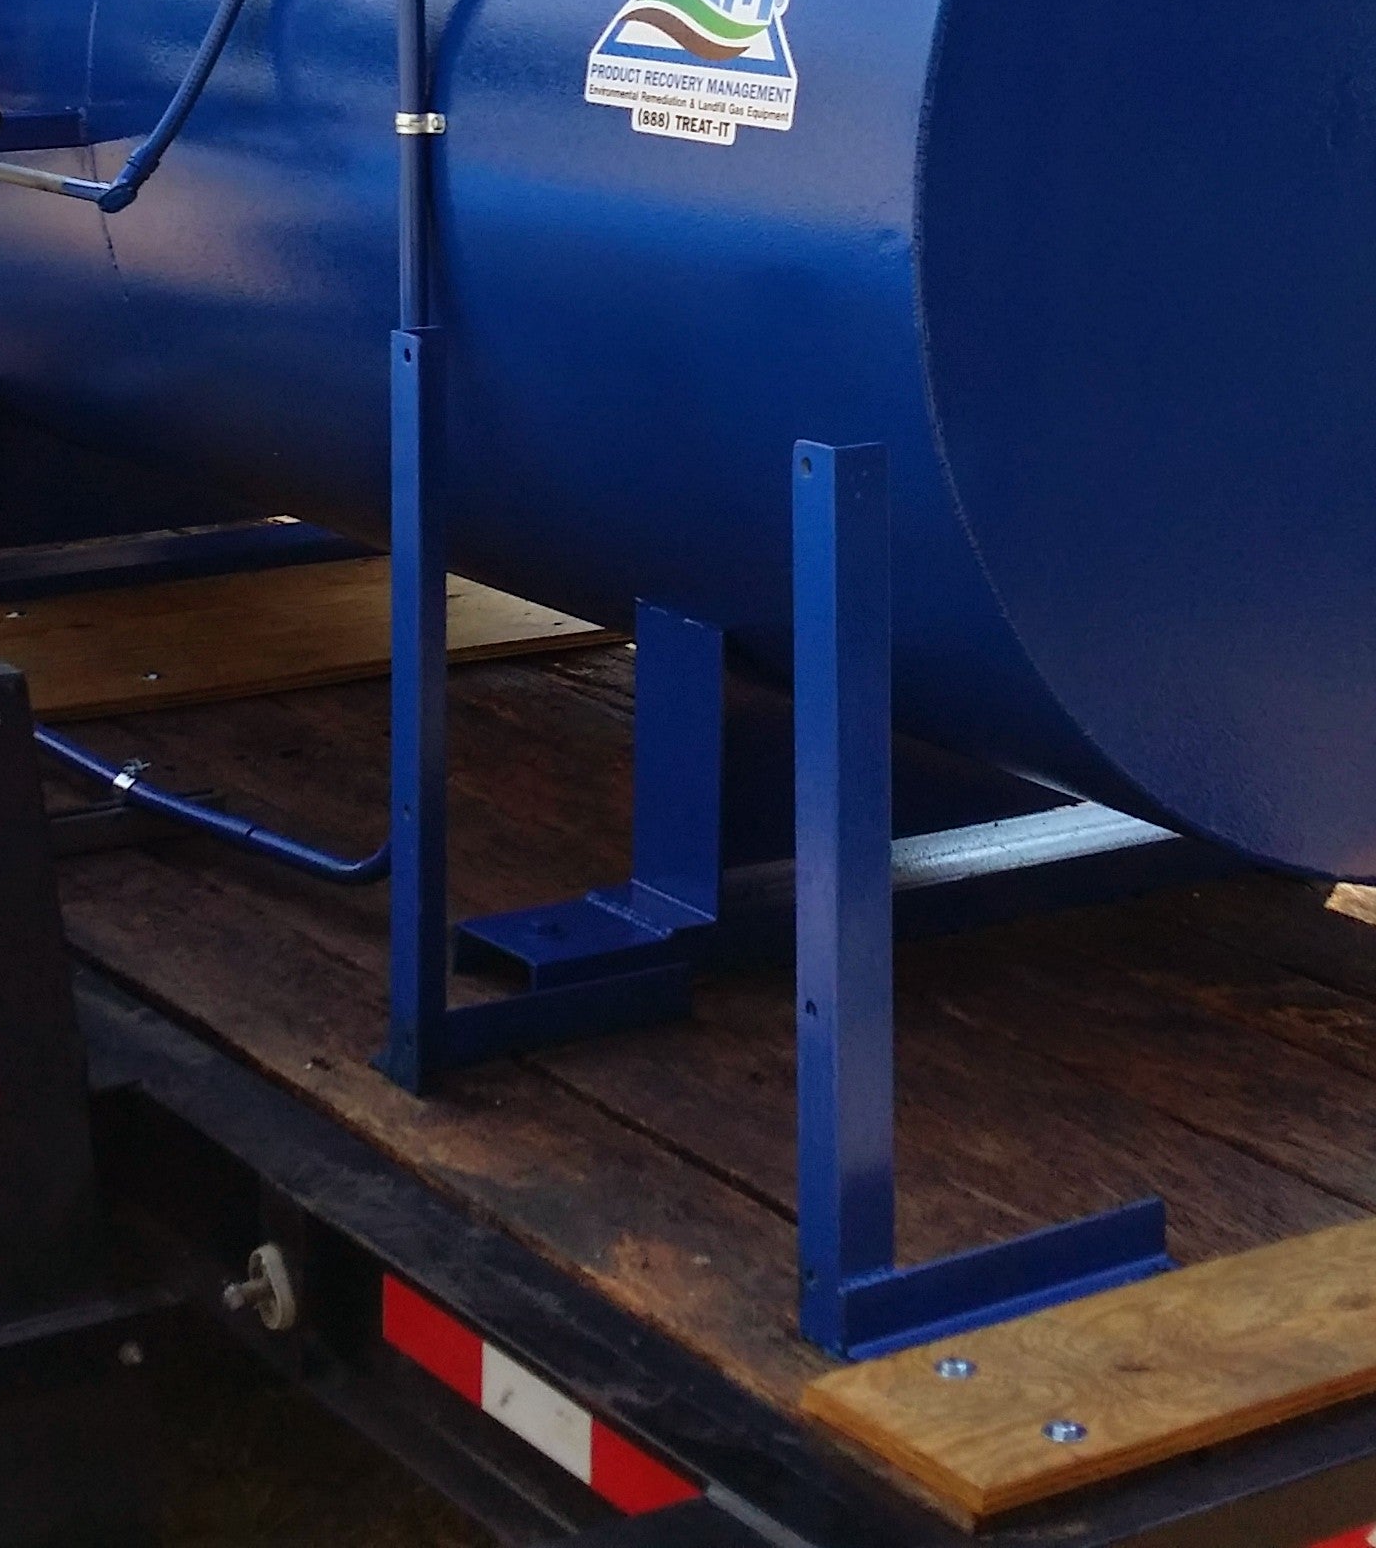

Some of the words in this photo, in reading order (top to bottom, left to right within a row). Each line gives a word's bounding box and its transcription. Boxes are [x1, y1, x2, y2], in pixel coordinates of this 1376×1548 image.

[590, 63, 641, 84] PRODUCT
[644, 70, 703, 92] RECOVERY
[706, 78, 791, 104] MANAGEMENT
[638, 108, 670, 131] (888)
[675, 115, 730, 137] TREAT-IT
[728, 103, 744, 116] Gas
